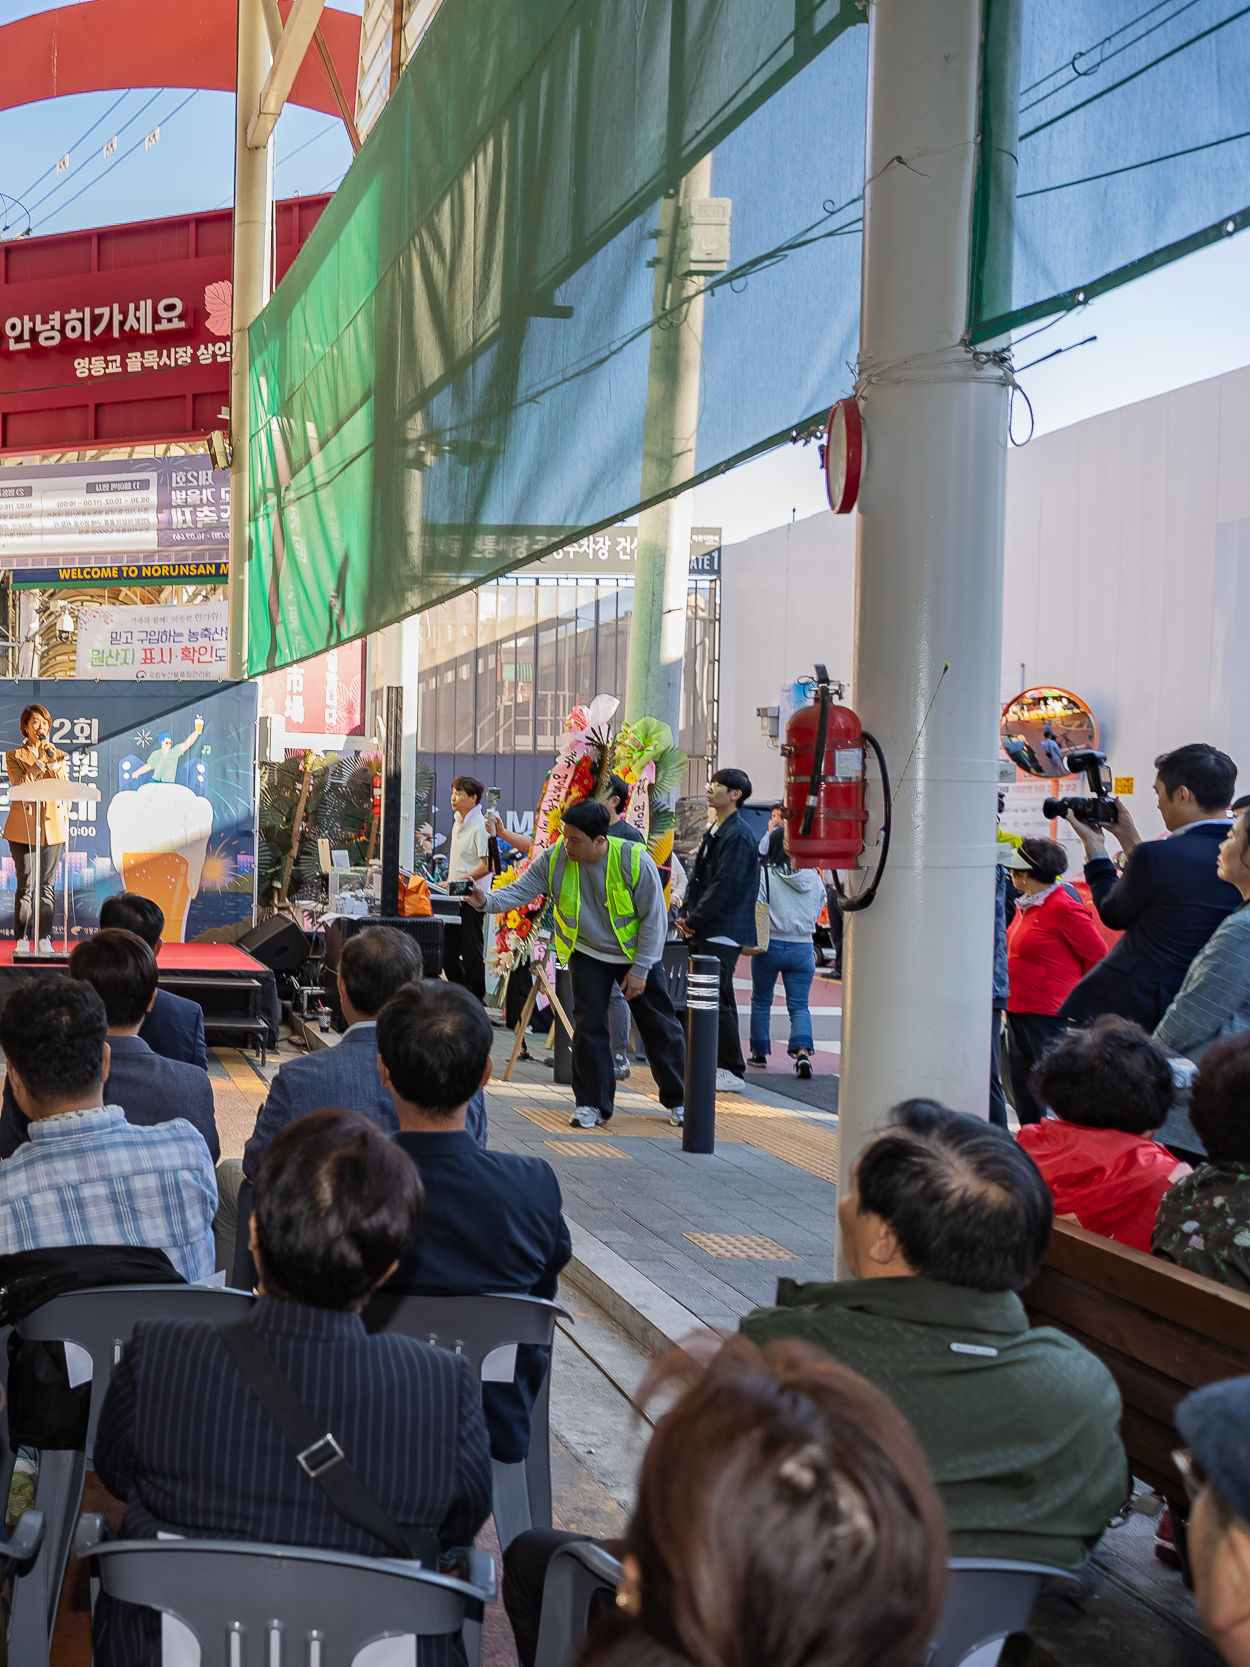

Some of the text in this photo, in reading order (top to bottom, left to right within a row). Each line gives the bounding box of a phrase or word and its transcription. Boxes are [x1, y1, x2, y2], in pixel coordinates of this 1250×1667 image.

[4, 297, 187, 352] 안녕히가세요
[73, 354, 123, 379] 영동교
[126, 343, 195, 373] 골목시장
[59, 566, 119, 580] WELCOME
[122, 566, 139, 579] TO
[142, 563, 216, 578] NORUNSAN
[110, 630, 134, 645] 믿고
[137, 629, 185, 645] 구입하는
[91, 648, 136, 667] 원산지
